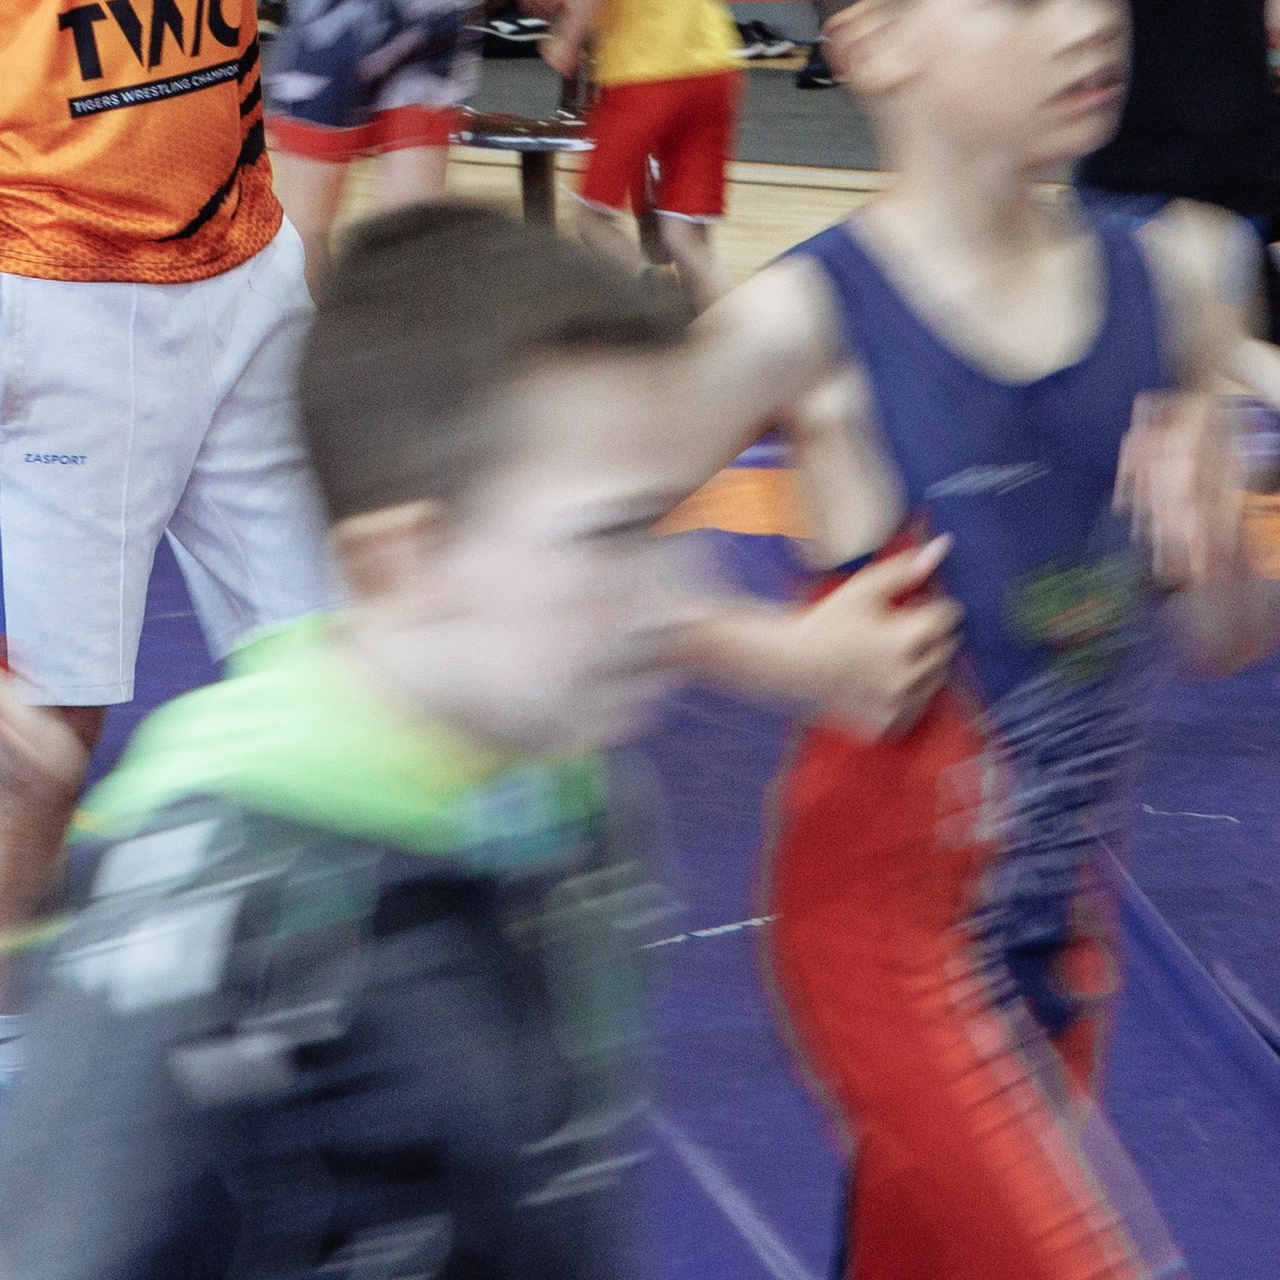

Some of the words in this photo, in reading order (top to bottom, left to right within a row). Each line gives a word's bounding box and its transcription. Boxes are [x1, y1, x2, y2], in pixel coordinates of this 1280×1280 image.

[73, 94, 120, 112] TIGERS
[120, 78, 192, 103] WRESTLING
[24, 453, 87, 466] ZASPORT
